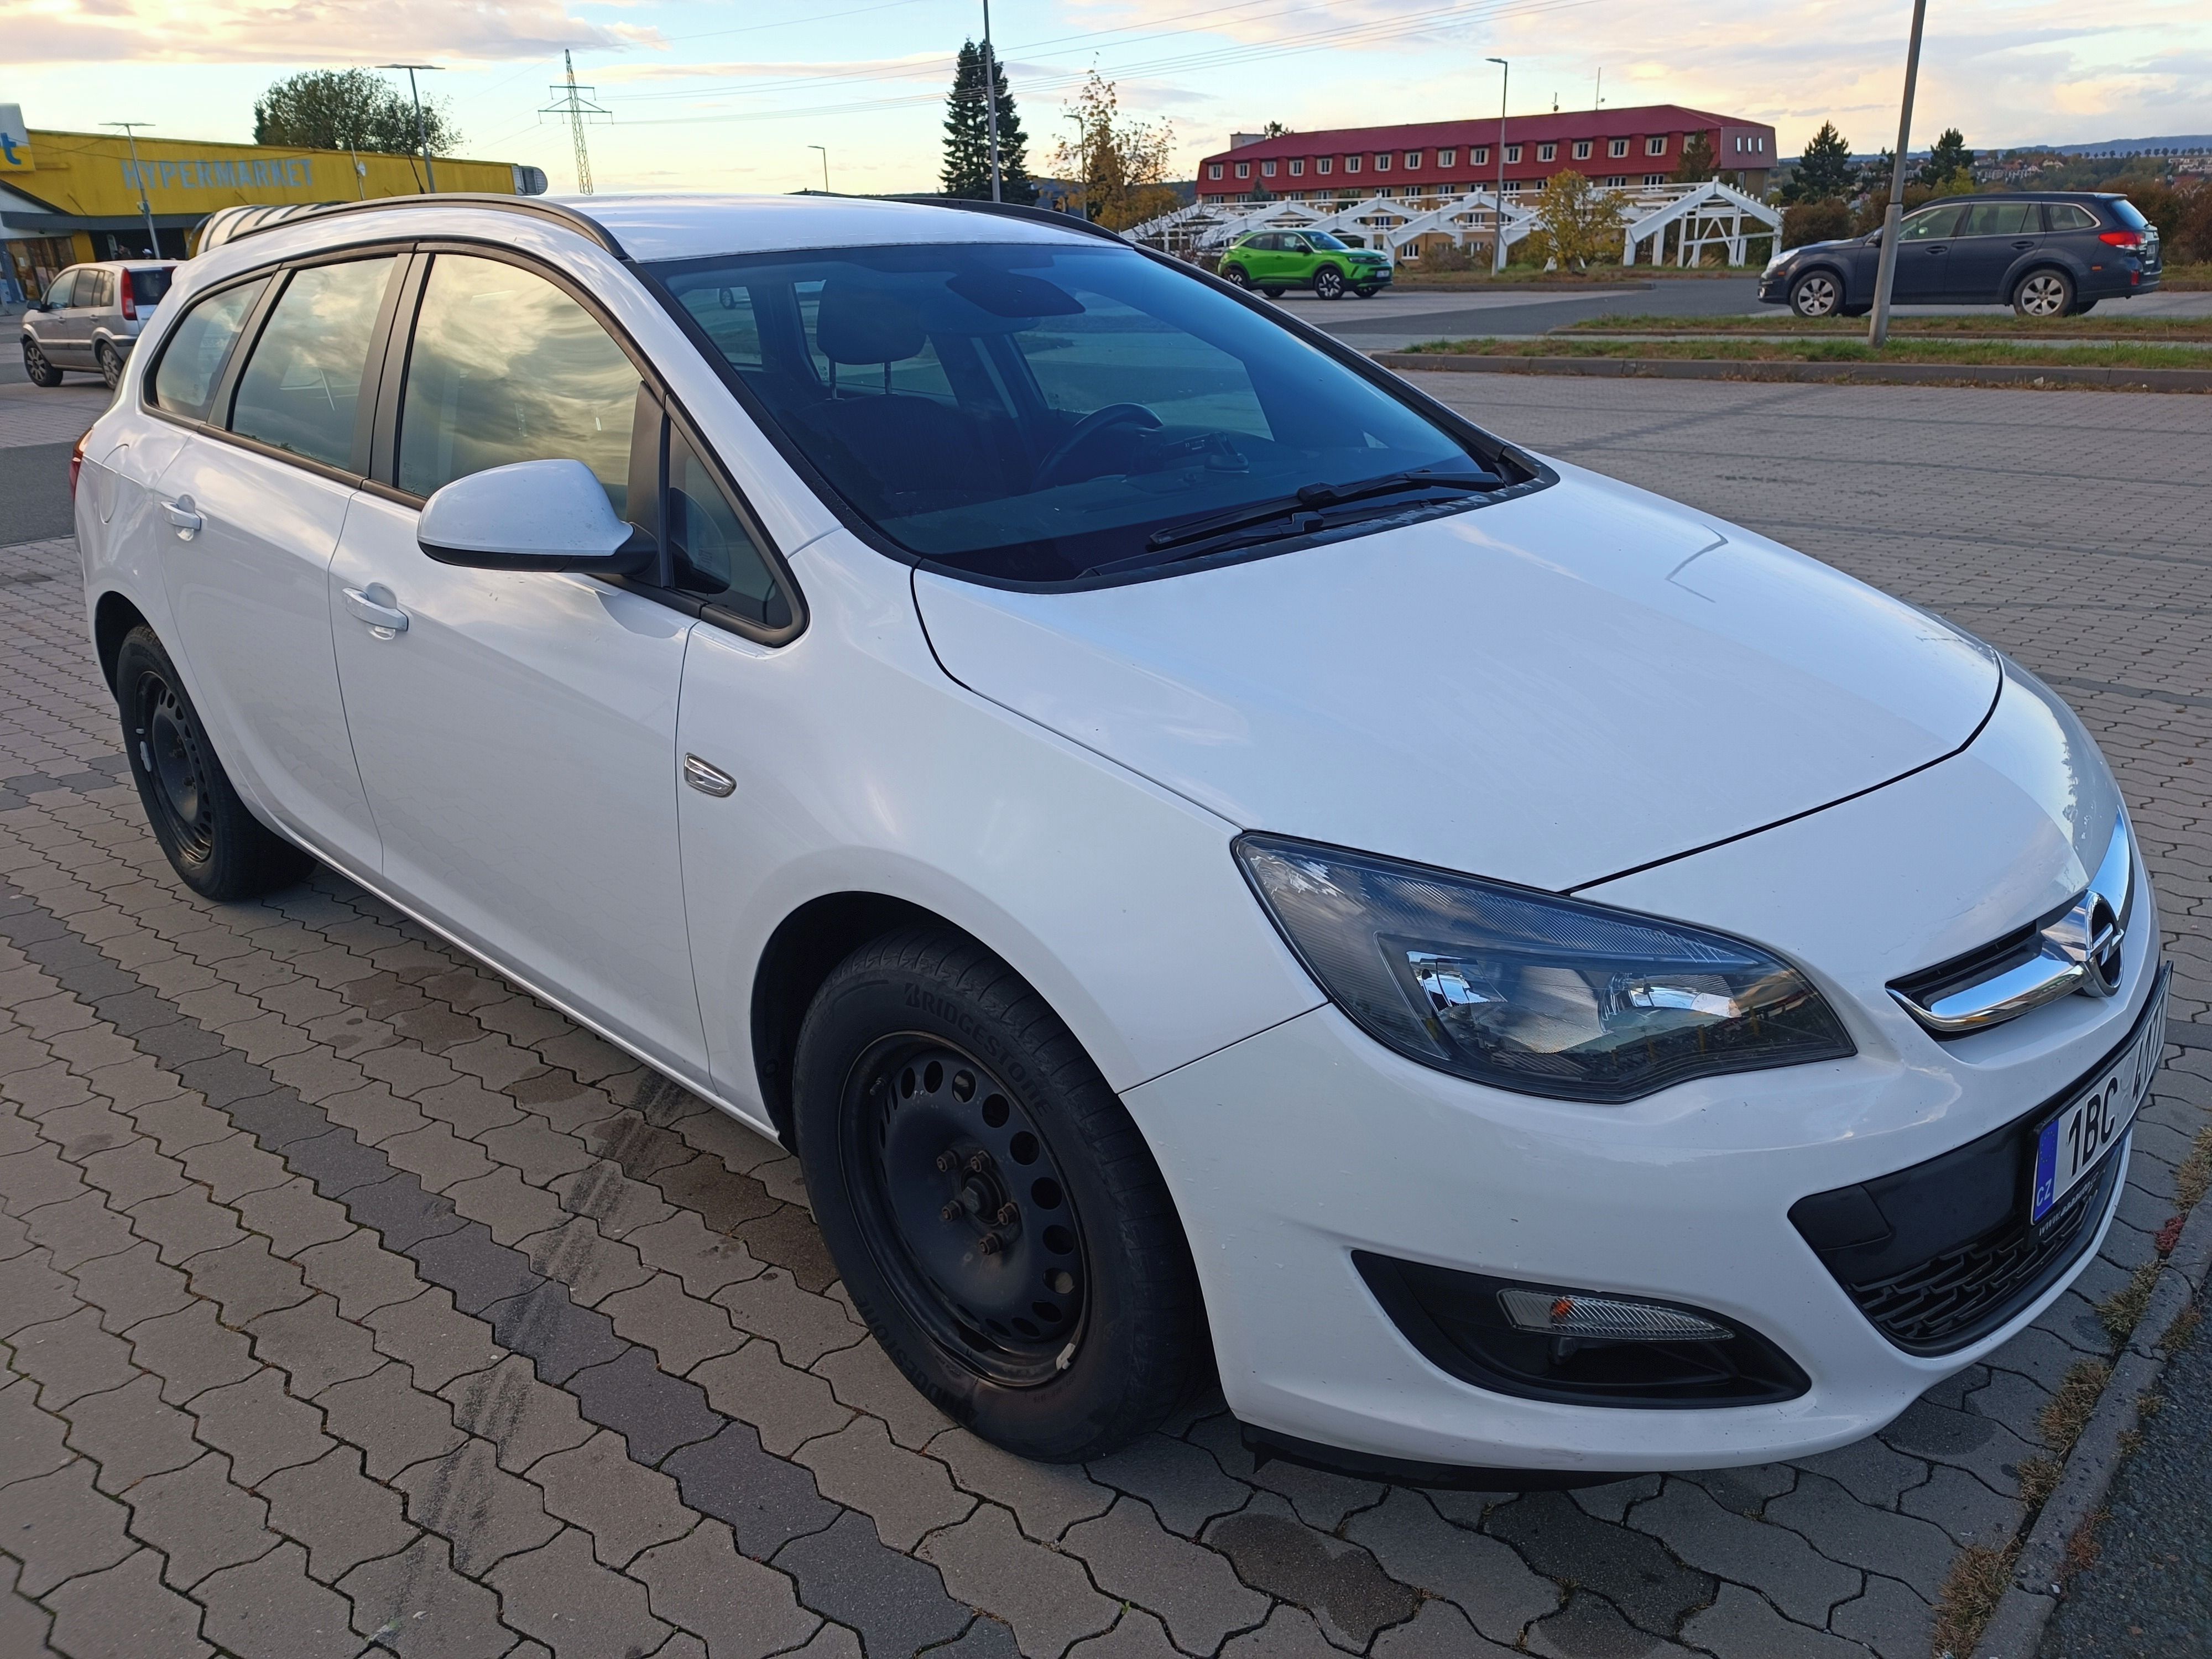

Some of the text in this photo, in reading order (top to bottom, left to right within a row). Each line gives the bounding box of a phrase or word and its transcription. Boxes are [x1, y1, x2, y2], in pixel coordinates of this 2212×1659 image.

[0, 132, 22, 165] t
[121, 158, 314, 190] HYPERMARKET
[903, 982, 1054, 1118] BRIDGESTONE
[2067, 1076, 2119, 1178] 1BC
[2036, 1177, 2052, 1207] CZ
